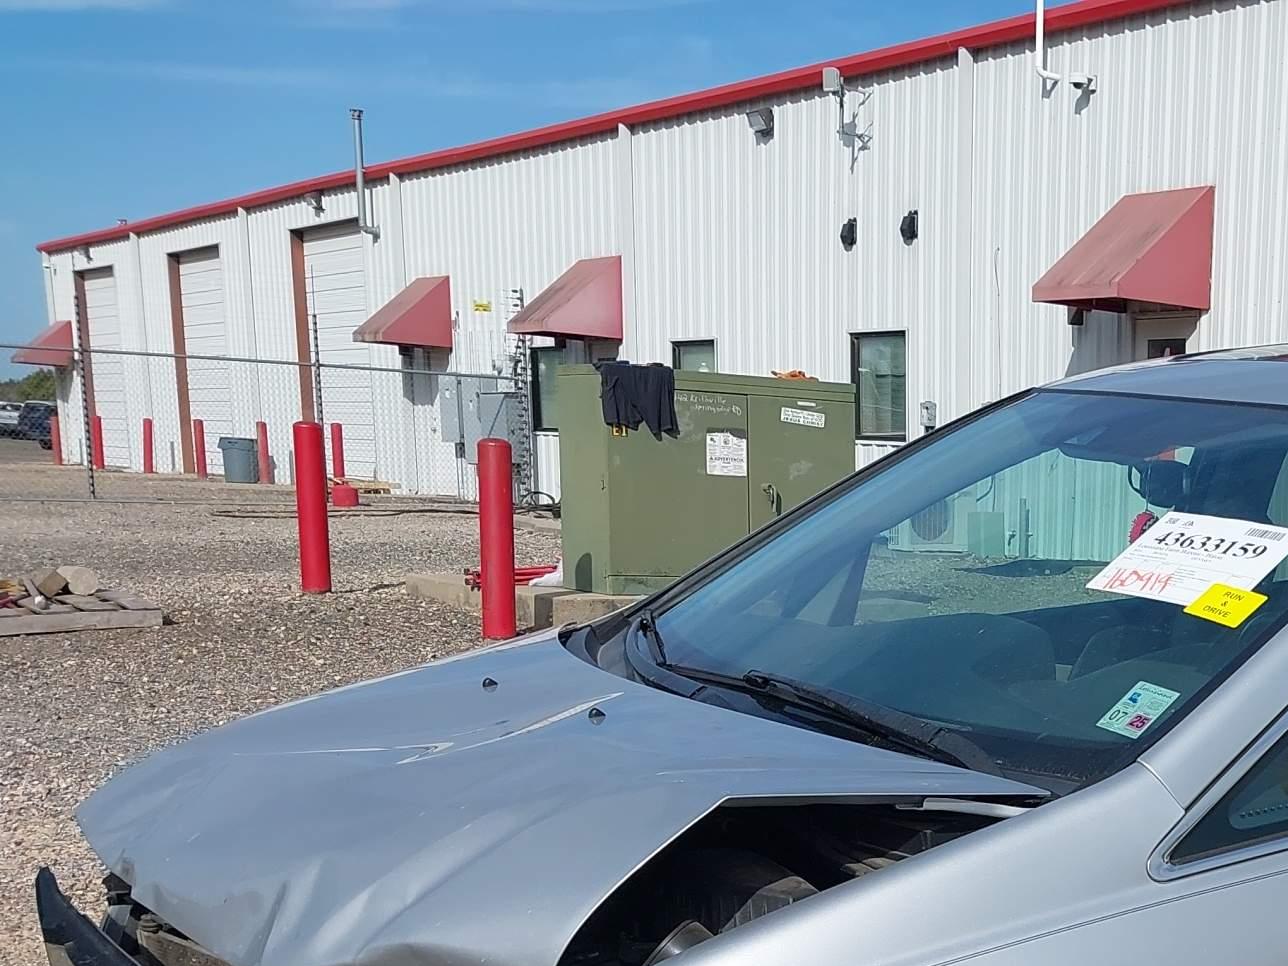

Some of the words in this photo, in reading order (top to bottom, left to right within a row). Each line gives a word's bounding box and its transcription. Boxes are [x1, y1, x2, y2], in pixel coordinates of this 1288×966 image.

[1154, 531, 1268, 560] 43633159
[1223, 590, 1245, 602] RUN
[1202, 604, 1231, 619] DRIVE
[1219, 600, 1230, 608] &
[1108, 709, 1129, 722] 07
[1129, 715, 1150, 729] 25
